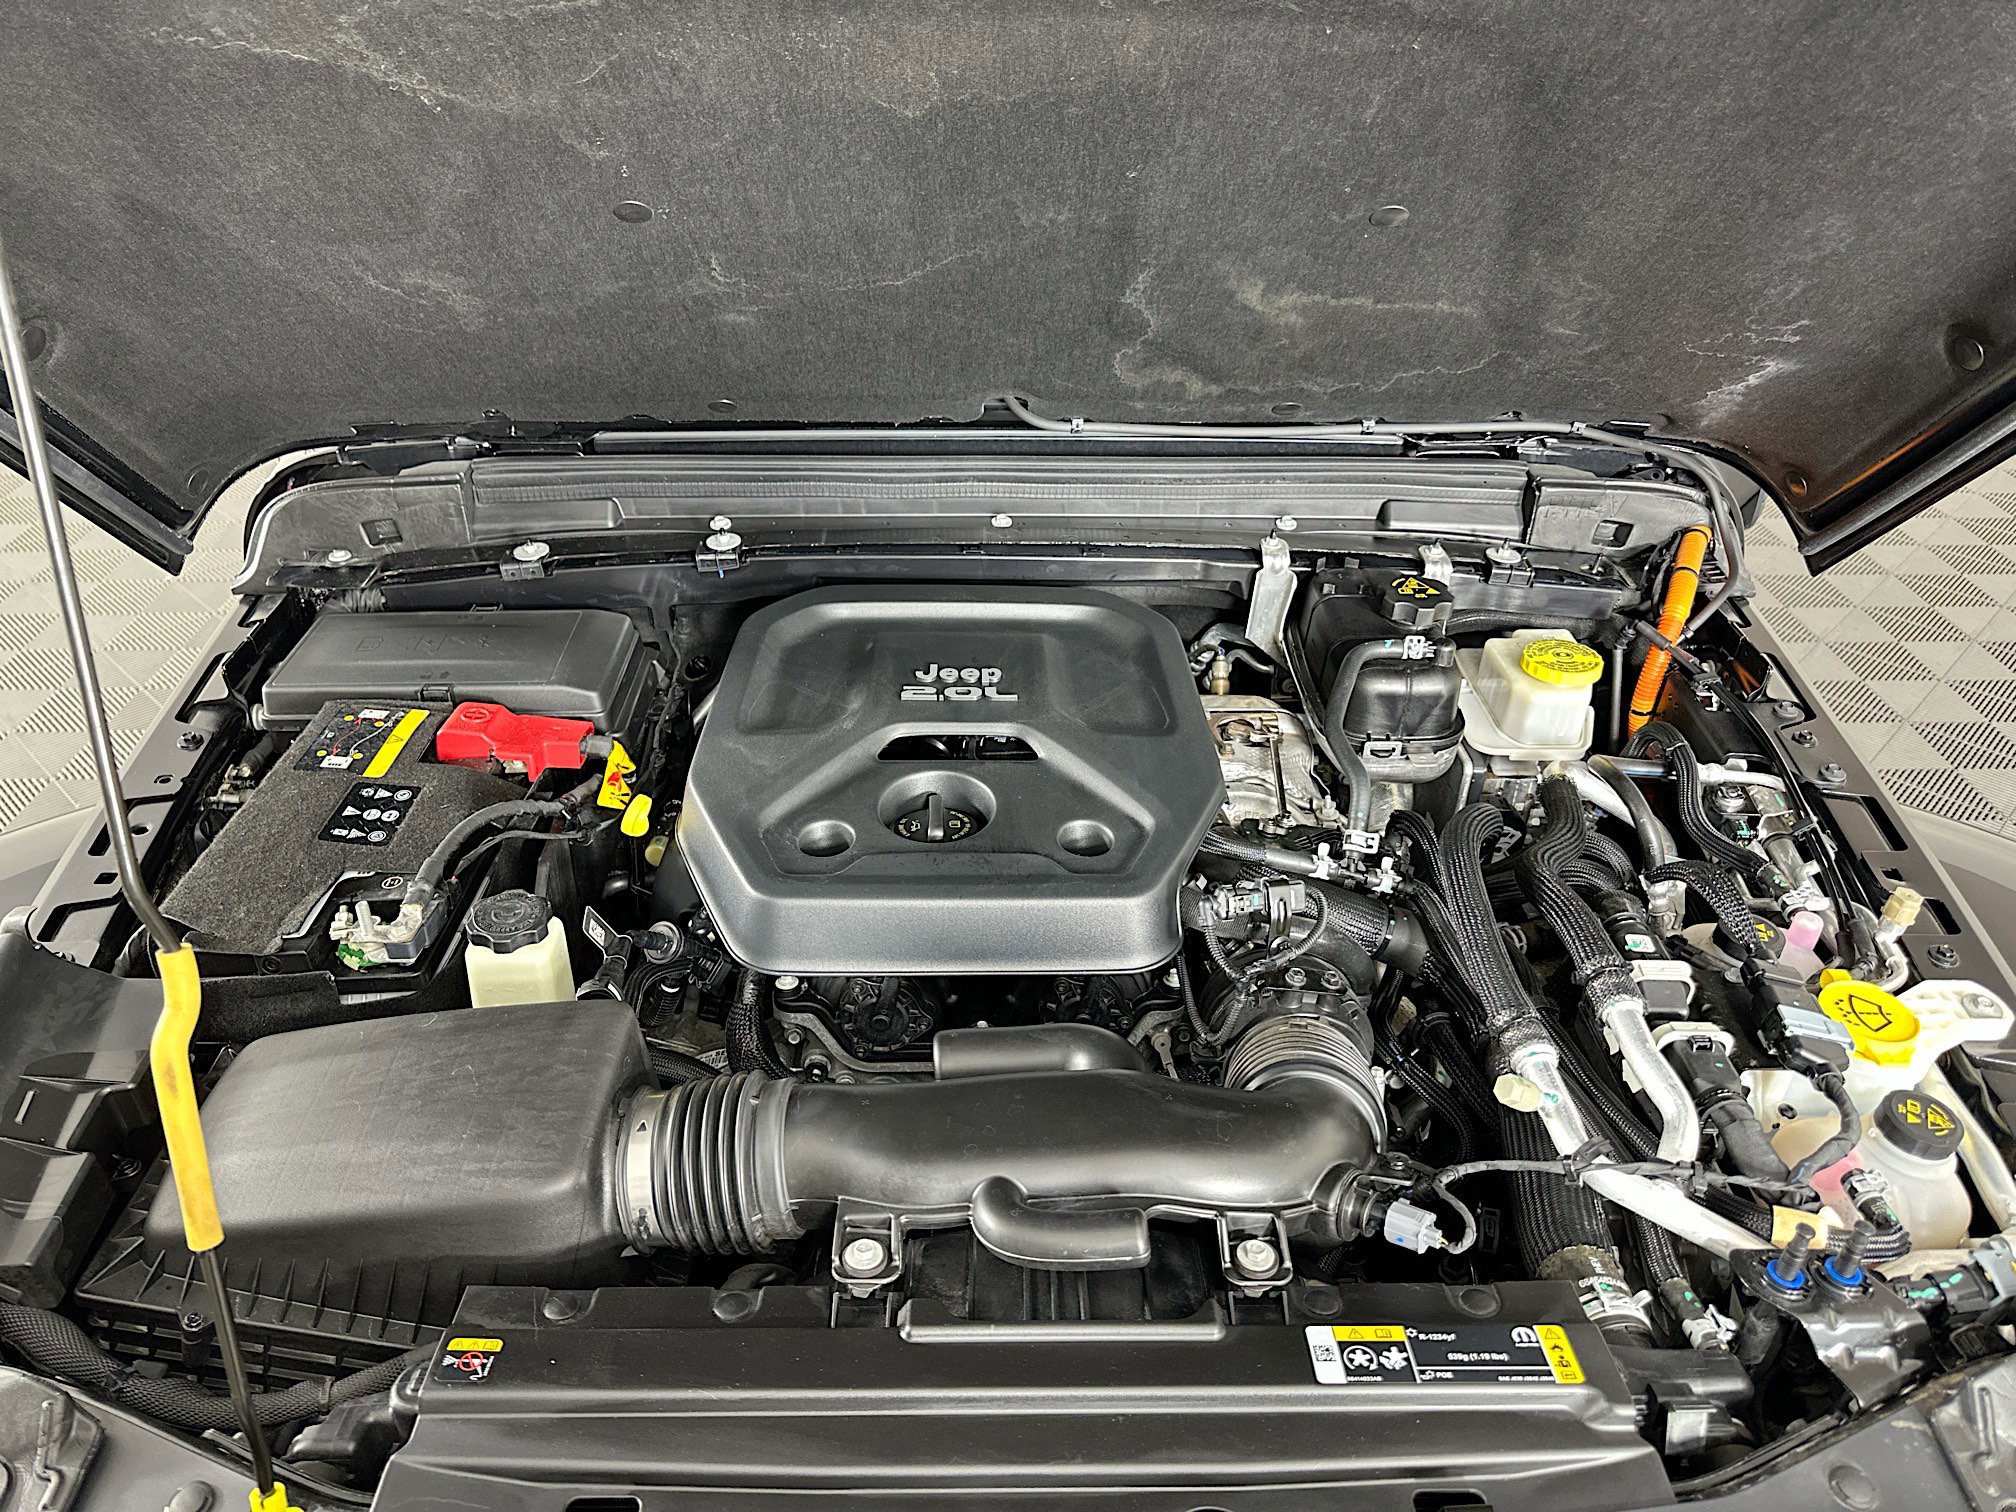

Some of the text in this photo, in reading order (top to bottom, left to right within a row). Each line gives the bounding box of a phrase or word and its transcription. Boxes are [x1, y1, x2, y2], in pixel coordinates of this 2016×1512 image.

[915, 663, 1002, 685] Jeep
[900, 685, 1019, 701] 2.0L
[1418, 1333, 1457, 1342] R-1234yf
[1491, 1352, 1509, 1361] lbs)
